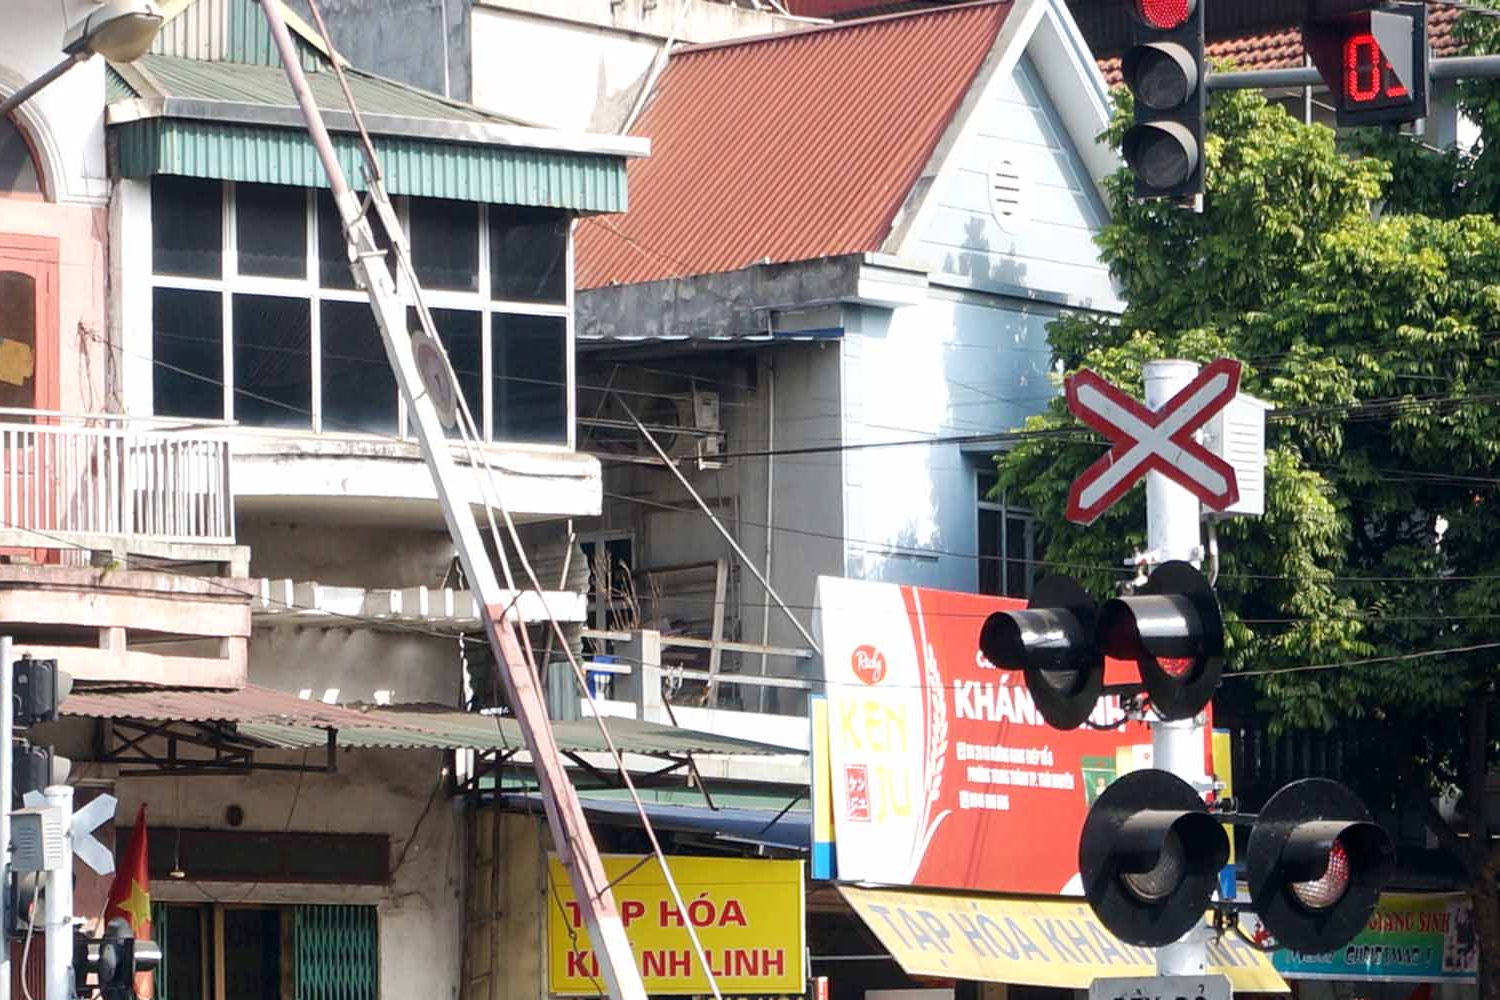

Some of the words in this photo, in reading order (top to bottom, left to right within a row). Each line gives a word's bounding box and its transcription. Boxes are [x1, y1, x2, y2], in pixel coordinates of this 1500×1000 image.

[839, 702, 907, 752] KEN
[876, 765, 913, 823] JU
[566, 900, 645, 928] TP
[660, 891, 747, 928] HÓA
[948, 902, 1050, 962] HÓA
[567, 942, 690, 977] KNH
[703, 950, 784, 977] LINH
